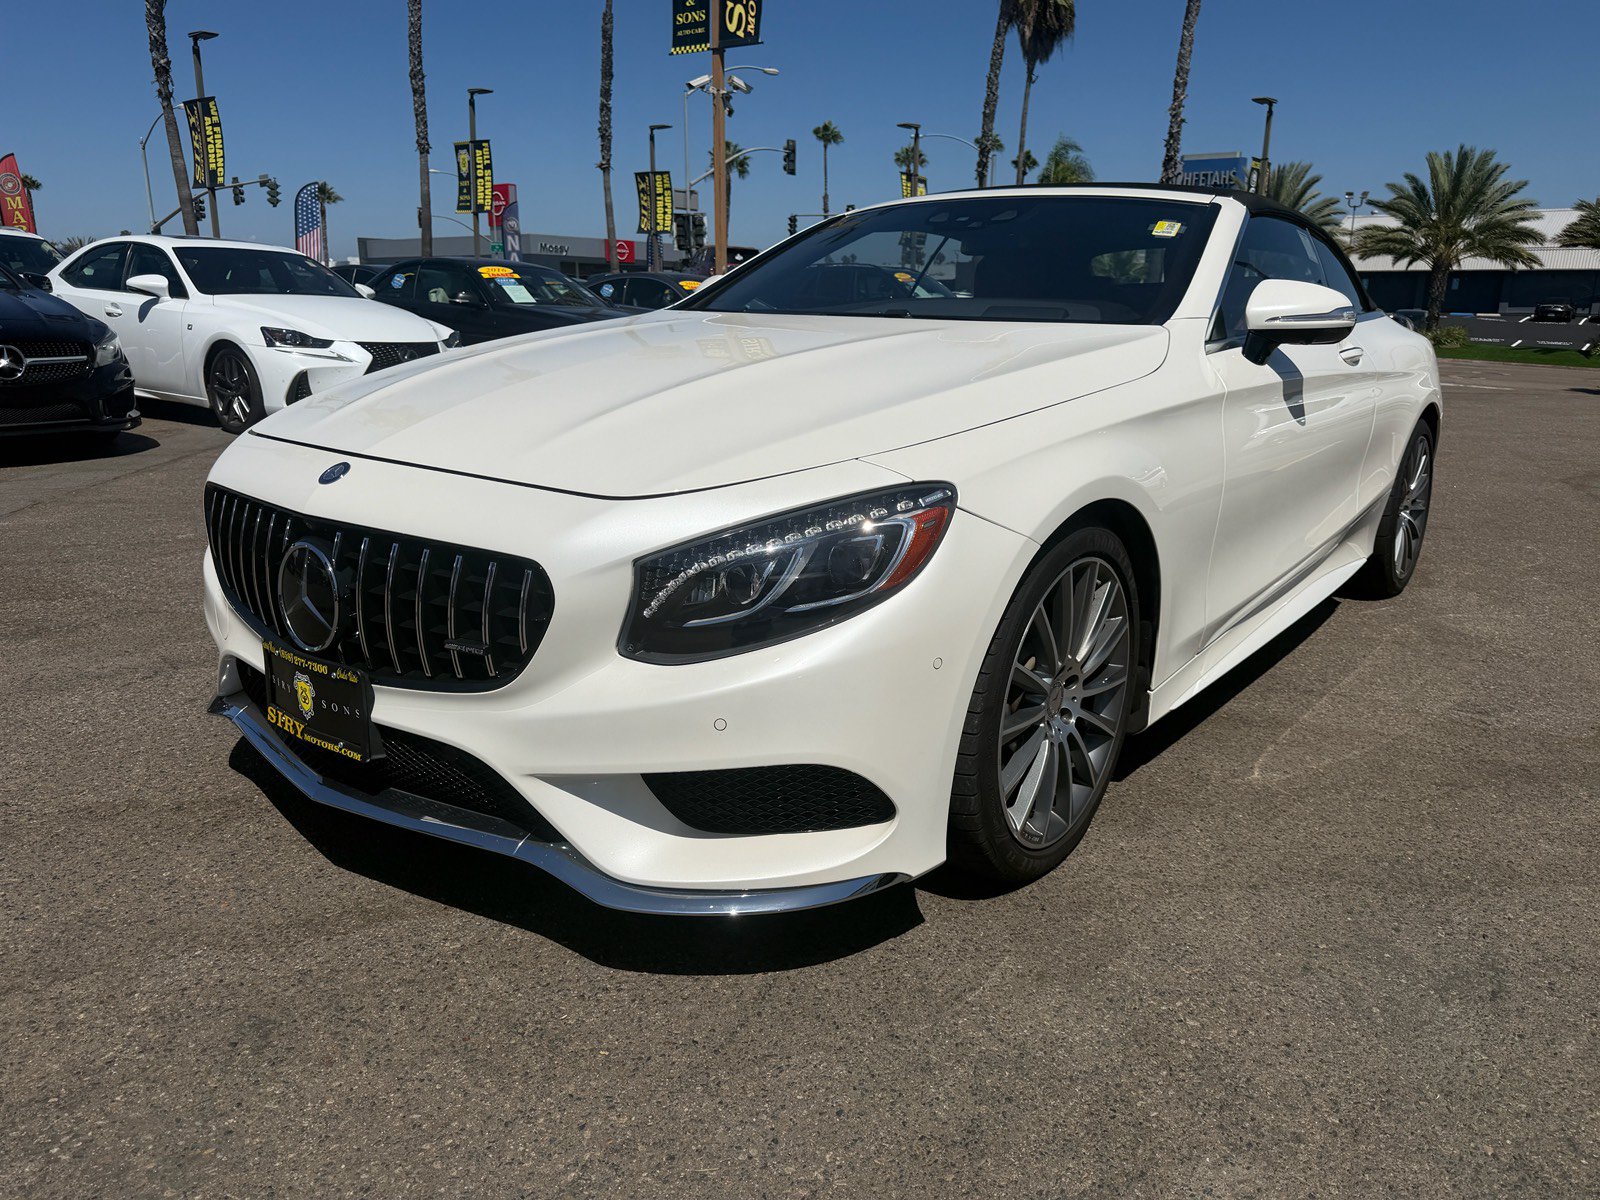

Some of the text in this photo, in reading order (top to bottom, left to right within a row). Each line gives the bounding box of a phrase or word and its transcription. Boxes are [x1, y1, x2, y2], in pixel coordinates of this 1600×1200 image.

[676, 10, 706, 25] SONS
[204, 116, 217, 171] ANYONE
[208, 100, 224, 184] WE FINANCE
[475, 149, 485, 205] AUTO CARE
[482, 142, 493, 211] FULL SERVICE
[656, 195, 664, 231] TROOPS
[664, 190, 672, 231] SUPPORT
[540, 242, 570, 256] Mossy
[272, 674, 291, 694] SIRY
[321, 699, 360, 719] SONS
